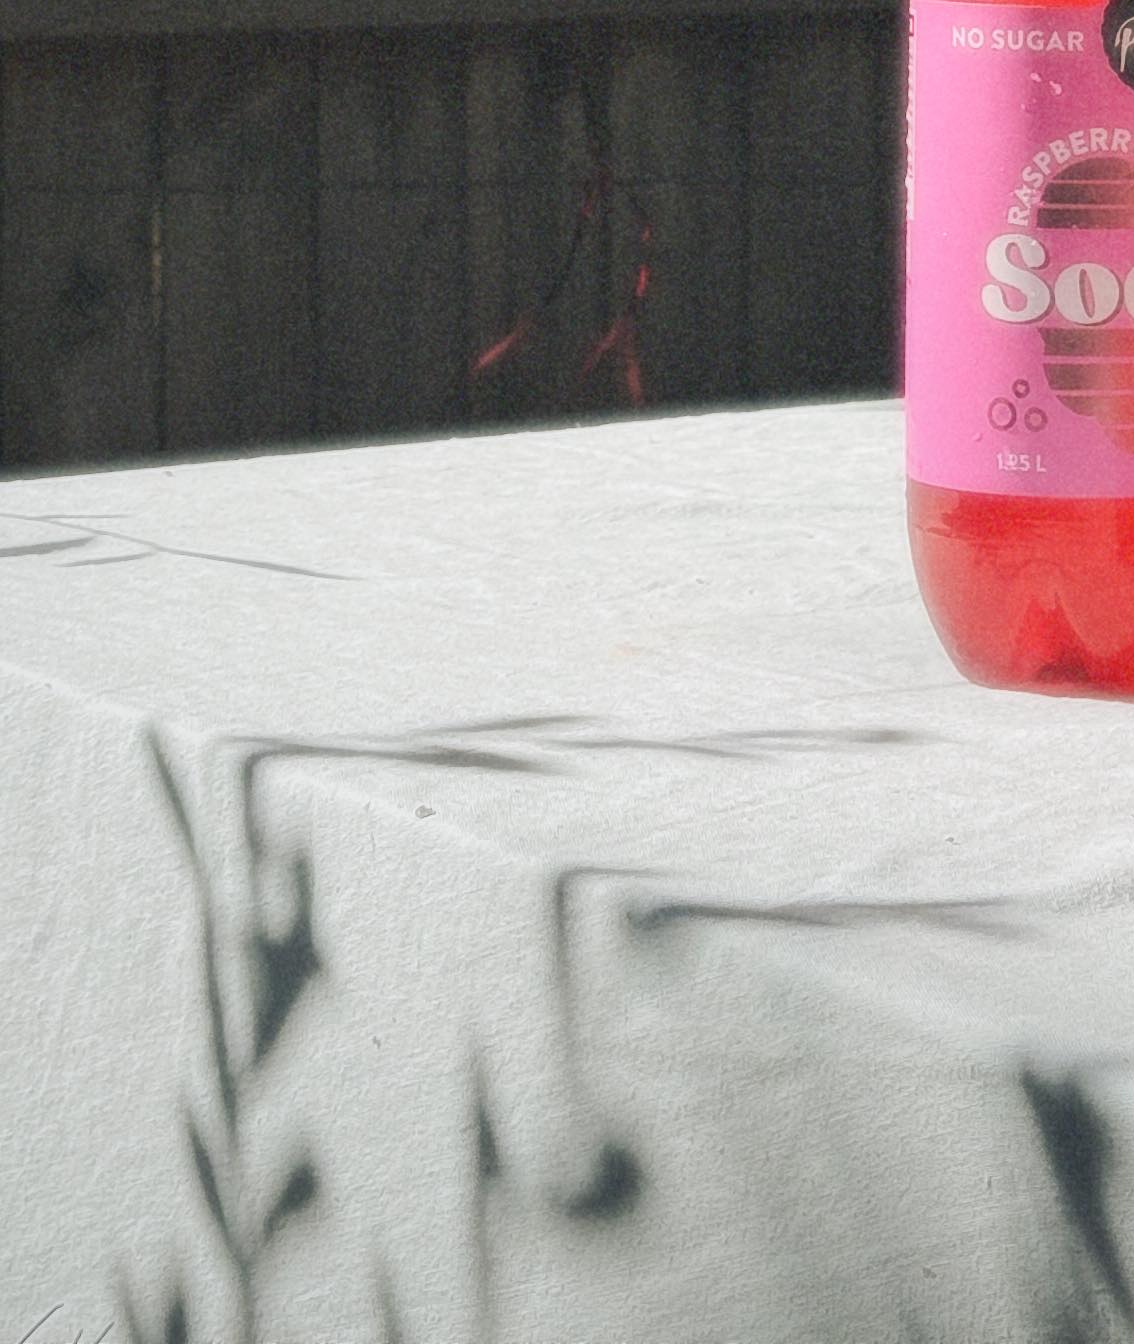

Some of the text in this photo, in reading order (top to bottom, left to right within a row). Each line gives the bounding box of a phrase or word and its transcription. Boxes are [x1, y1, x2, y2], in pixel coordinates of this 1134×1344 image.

[952, 25, 1085, 52] NO SUGAR
[1036, 454, 1048, 473] L
